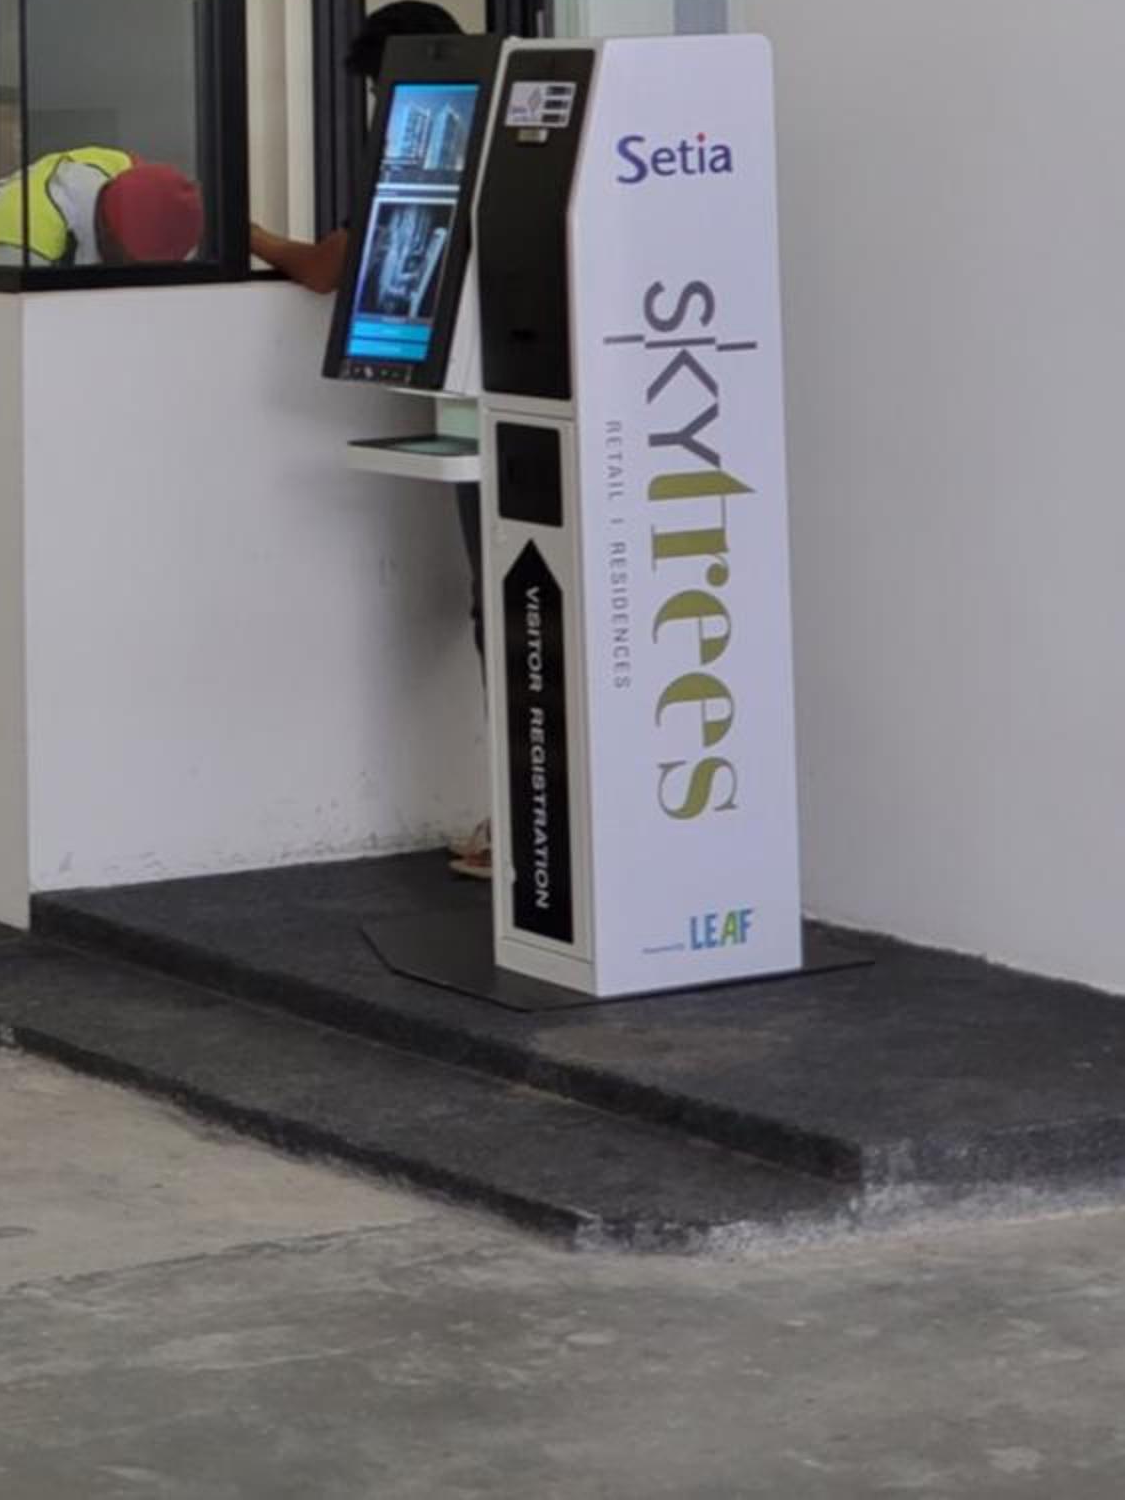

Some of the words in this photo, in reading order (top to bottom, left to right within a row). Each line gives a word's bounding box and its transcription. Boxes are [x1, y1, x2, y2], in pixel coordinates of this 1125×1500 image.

[615, 133, 733, 184] Setia
[605, 420, 624, 501] RETAIL
[525, 586, 543, 693] VISITOR
[609, 541, 631, 689] RESIDENCES
[530, 707, 550, 909] REGISTRATION
[690, 908, 754, 950] LEAF
